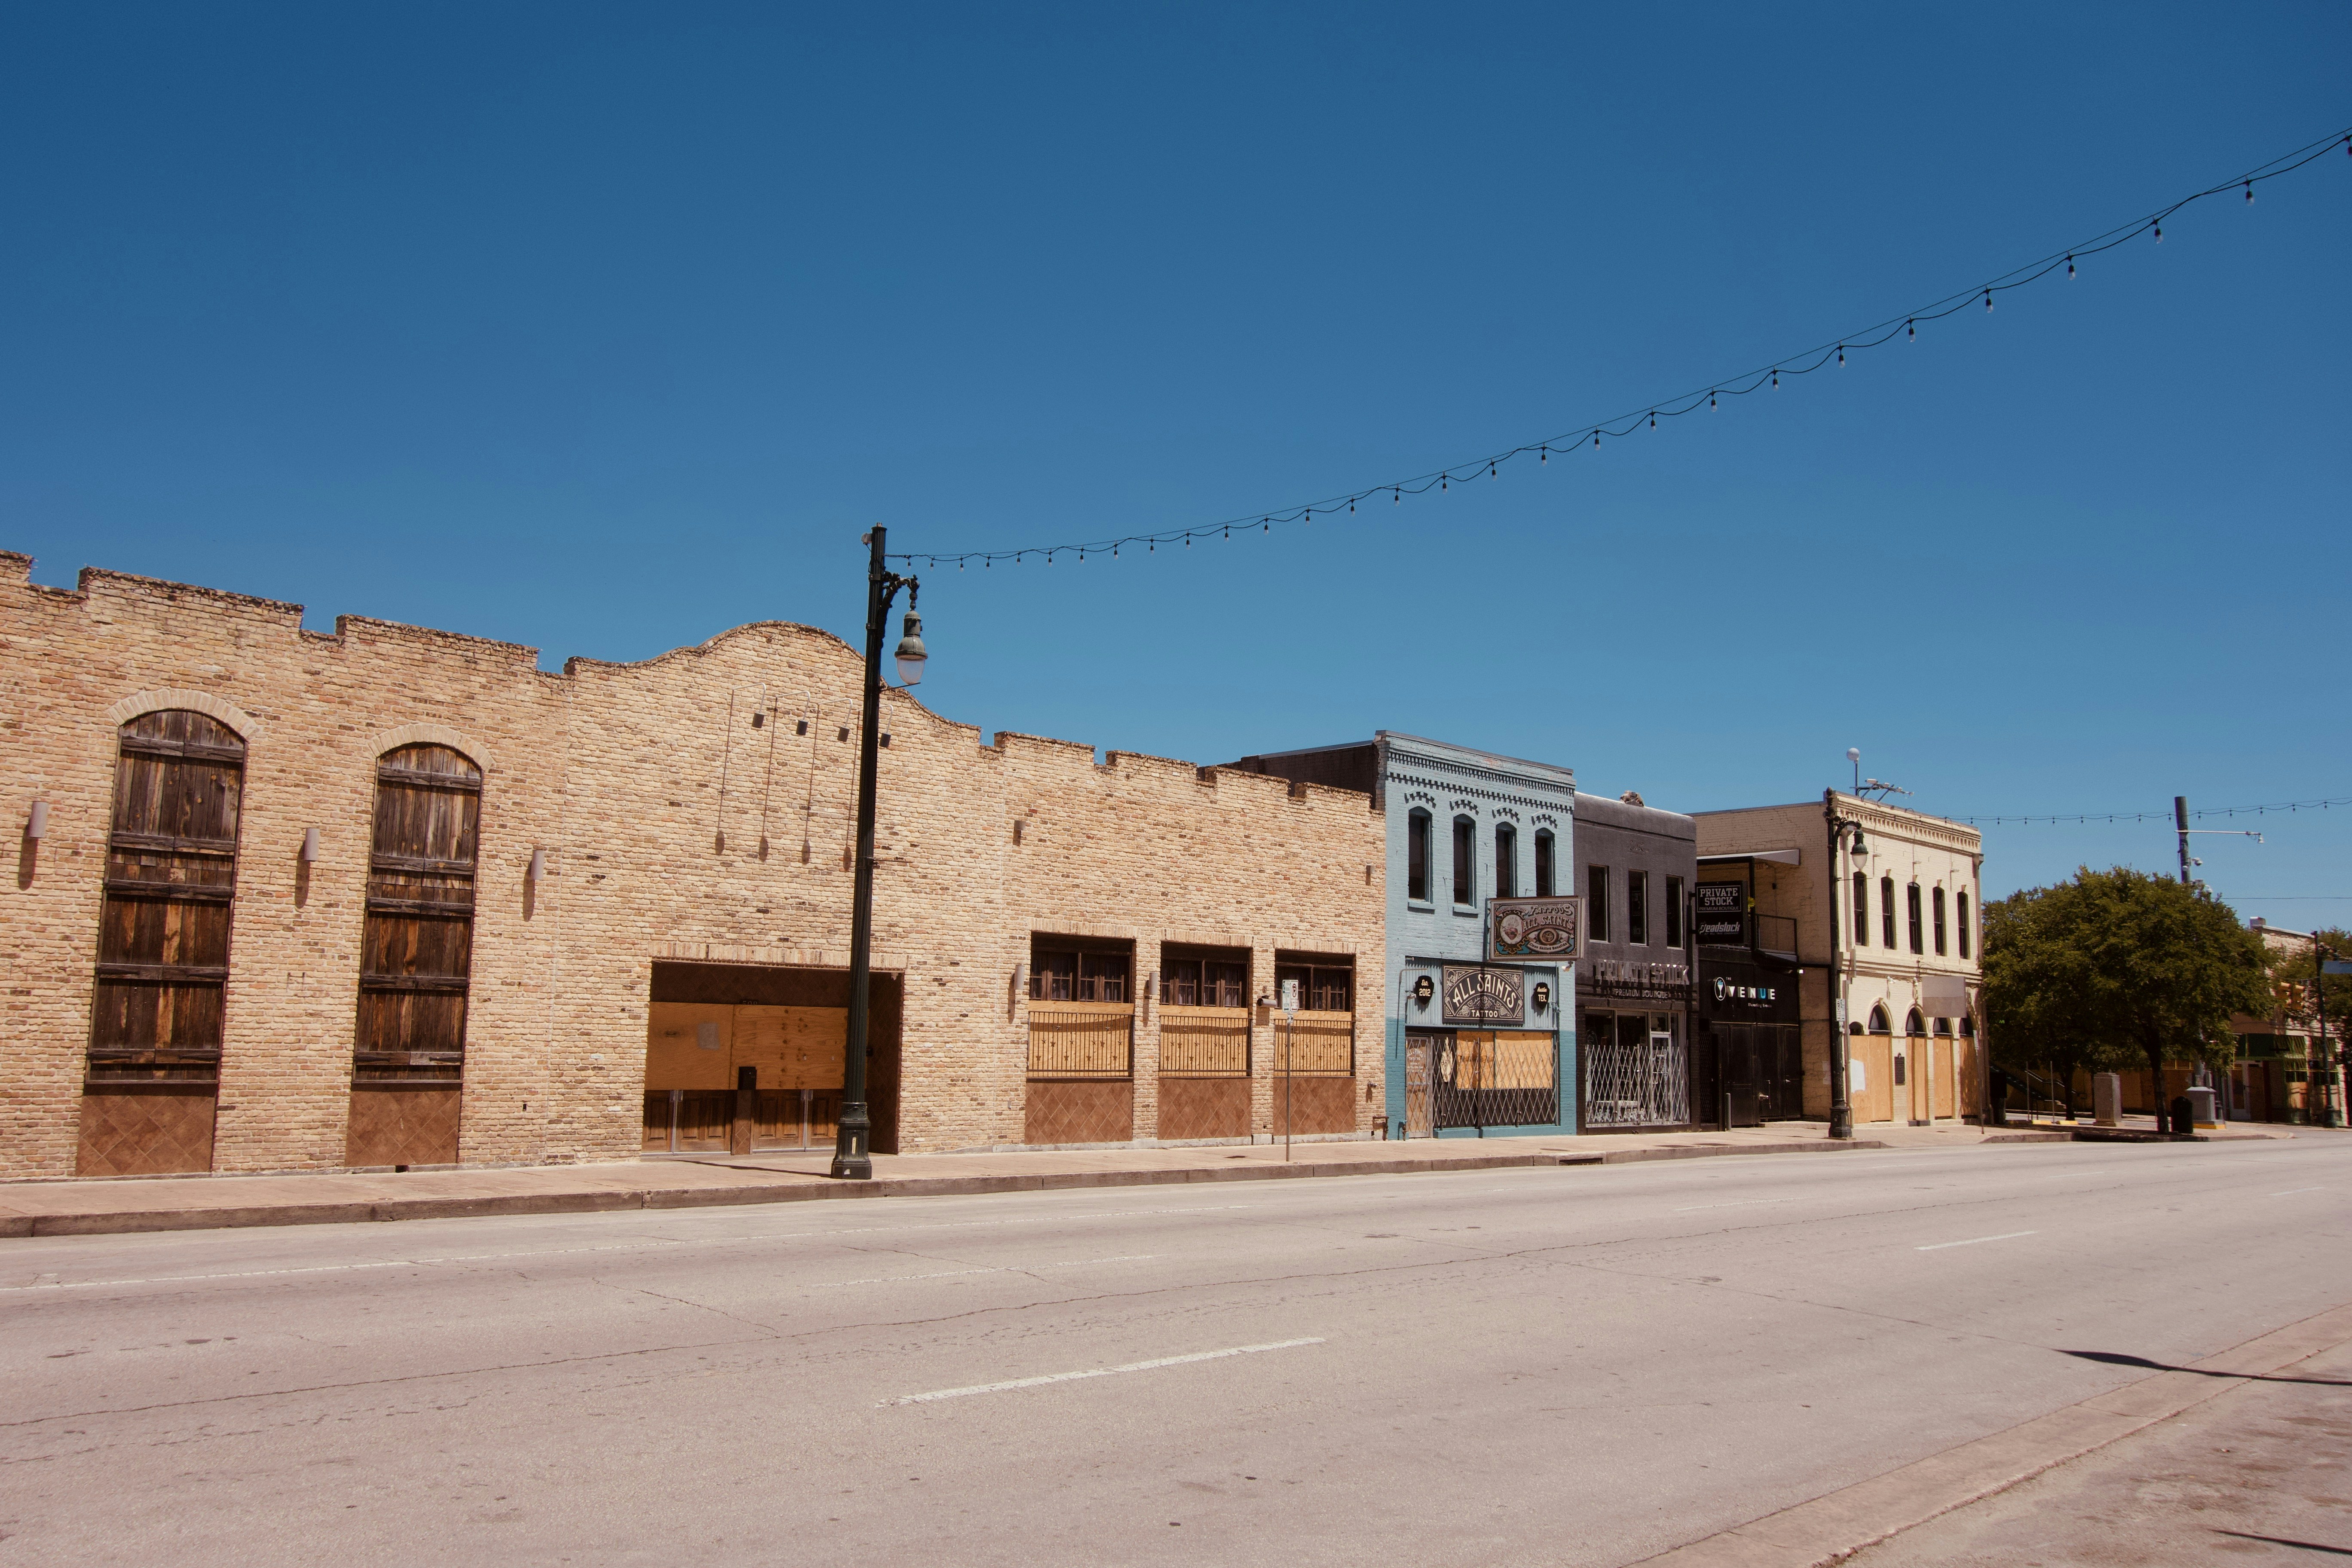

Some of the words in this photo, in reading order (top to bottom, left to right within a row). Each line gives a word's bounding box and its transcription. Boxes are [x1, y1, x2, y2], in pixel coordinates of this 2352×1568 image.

[1700, 888, 1738, 897] PRIVATE
[1705, 897, 1733, 905] STOCK
[1528, 903, 1573, 916] TATTOOS
[1523, 917, 1538, 932] ALL
[1540, 916, 1574, 929] SAINTS
[1595, 959, 1648, 983] PRIVATE
[1651, 963, 1690, 985] STOCK
[1419, 988, 1431, 996] 2012
[1452, 977, 1475, 1007] ALL
[1477, 974, 1516, 1008] SAINTS
[1614, 989, 1639, 997] PREMIUM
[1642, 990, 1669, 998] BOUTIQUE
[1726, 986, 1775, 1000] VENUE
